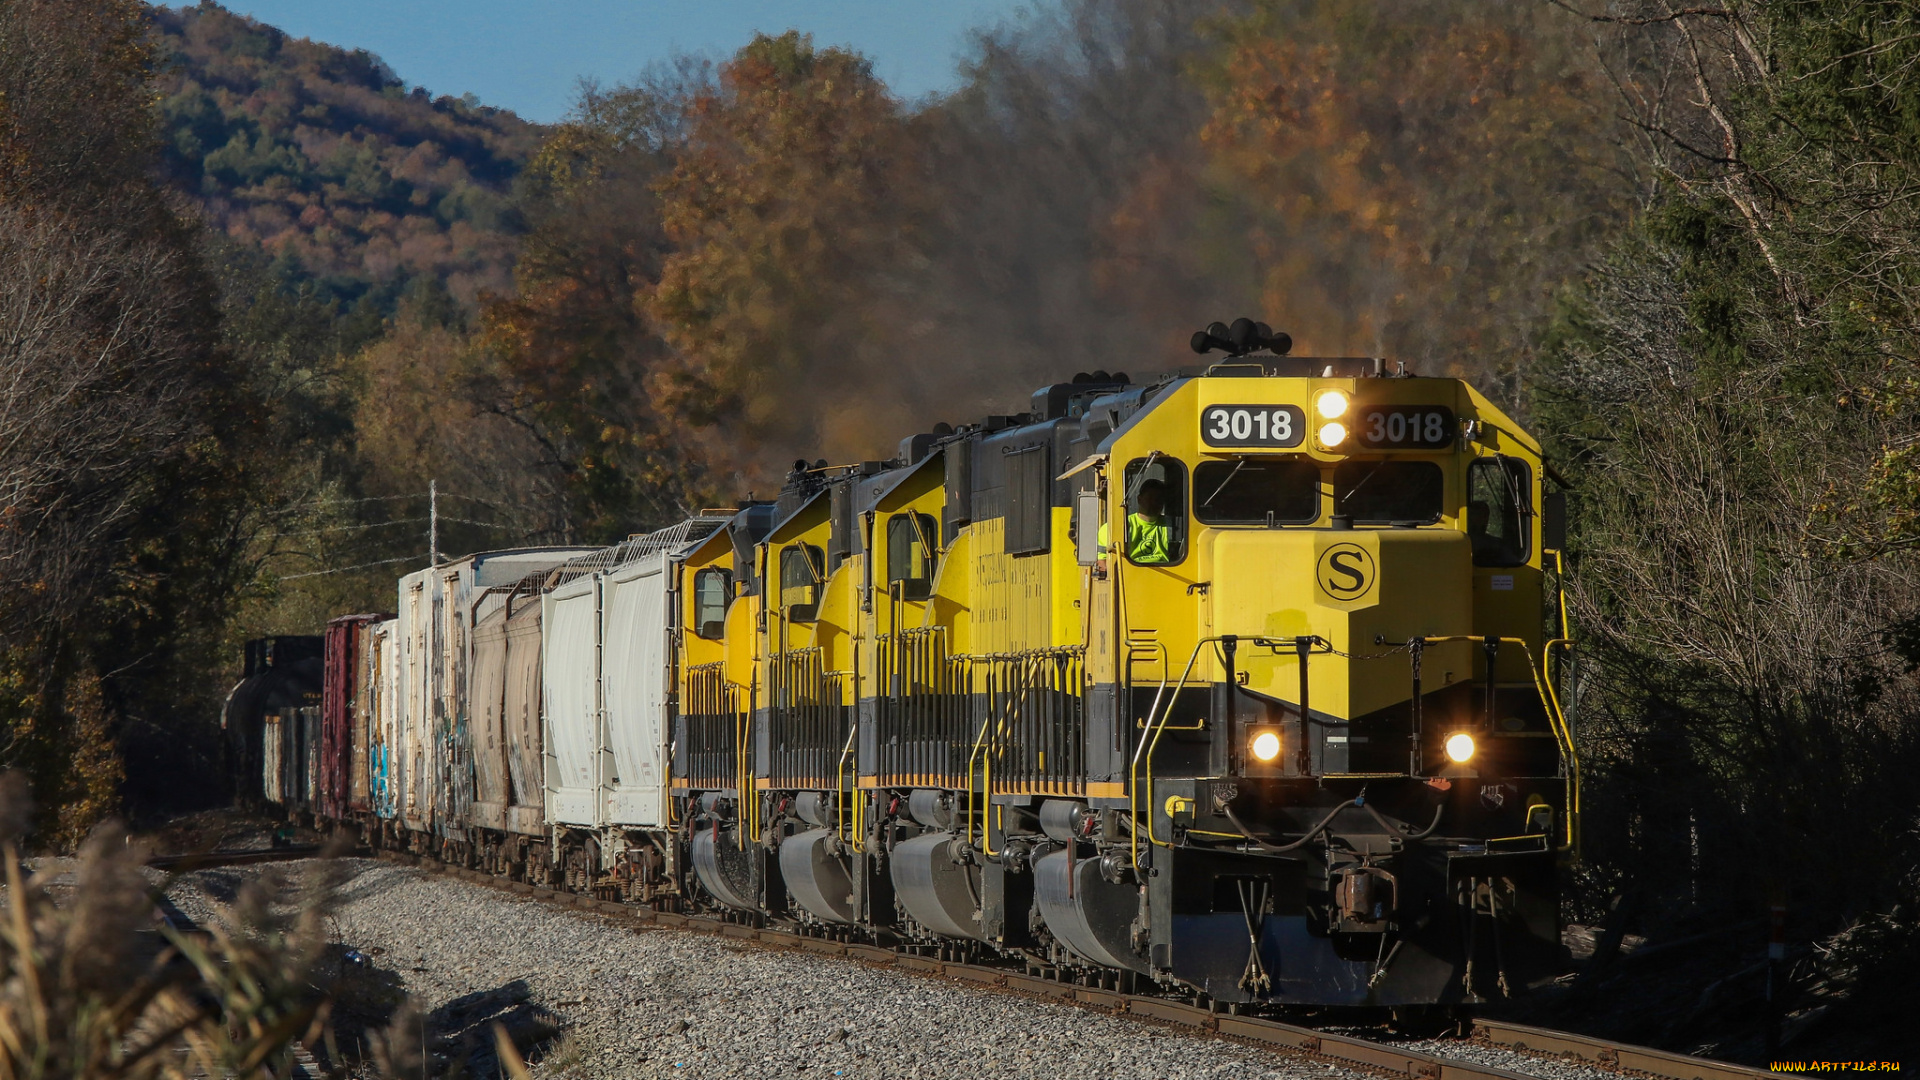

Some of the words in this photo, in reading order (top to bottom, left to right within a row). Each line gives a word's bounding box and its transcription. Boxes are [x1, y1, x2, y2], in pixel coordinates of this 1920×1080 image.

[1209, 409, 1292, 440] 3018
[1366, 412, 1444, 442] 3018
[1328, 550, 1365, 592] S
